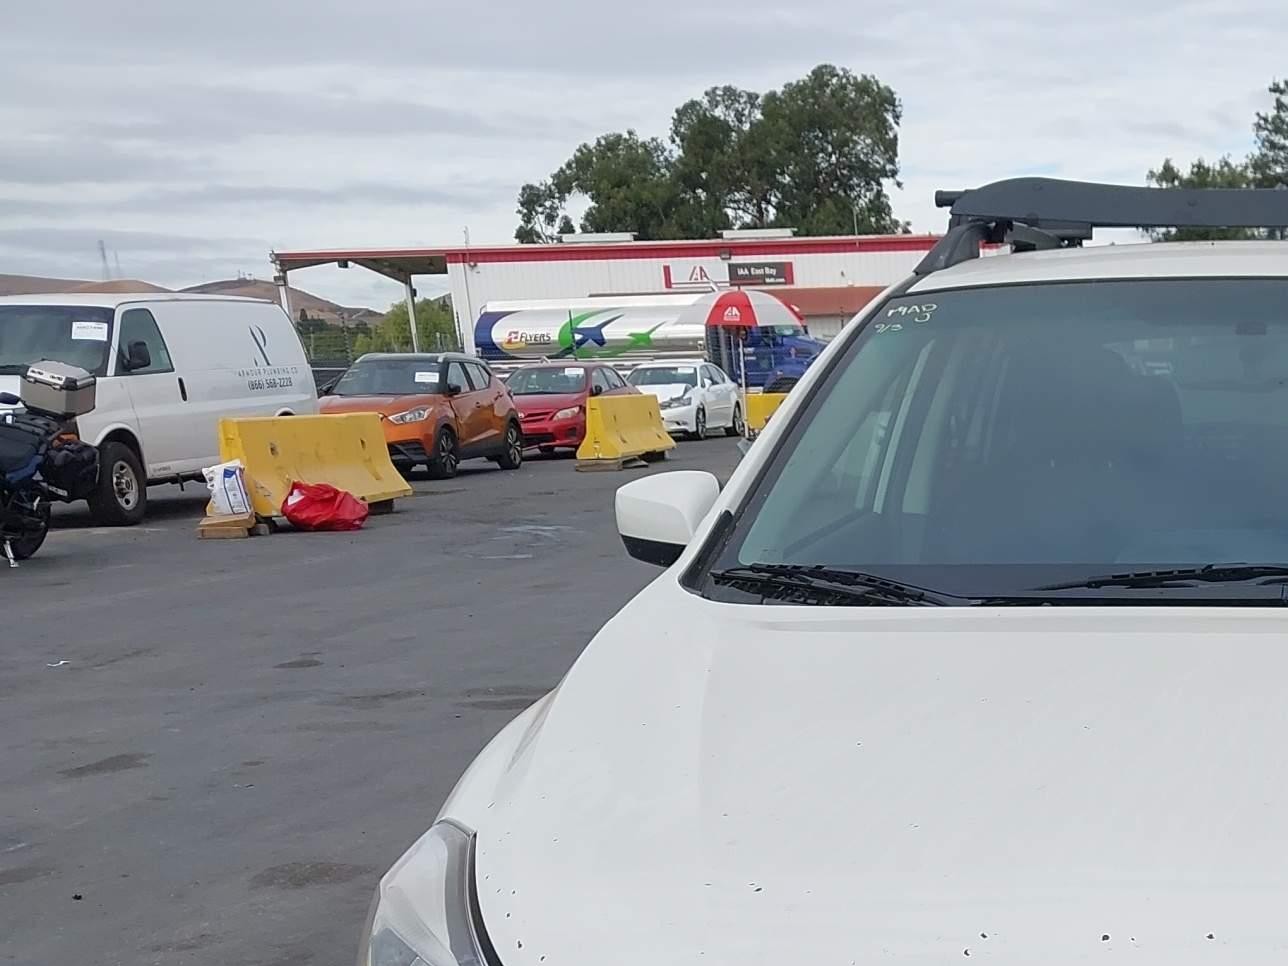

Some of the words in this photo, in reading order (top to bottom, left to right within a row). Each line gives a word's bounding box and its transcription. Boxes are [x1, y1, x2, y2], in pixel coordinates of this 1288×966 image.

[737, 267, 749, 276] IAA
[750, 267, 764, 275] East
[765, 266, 777, 276] Bay
[519, 332, 551, 344] FLYERS
